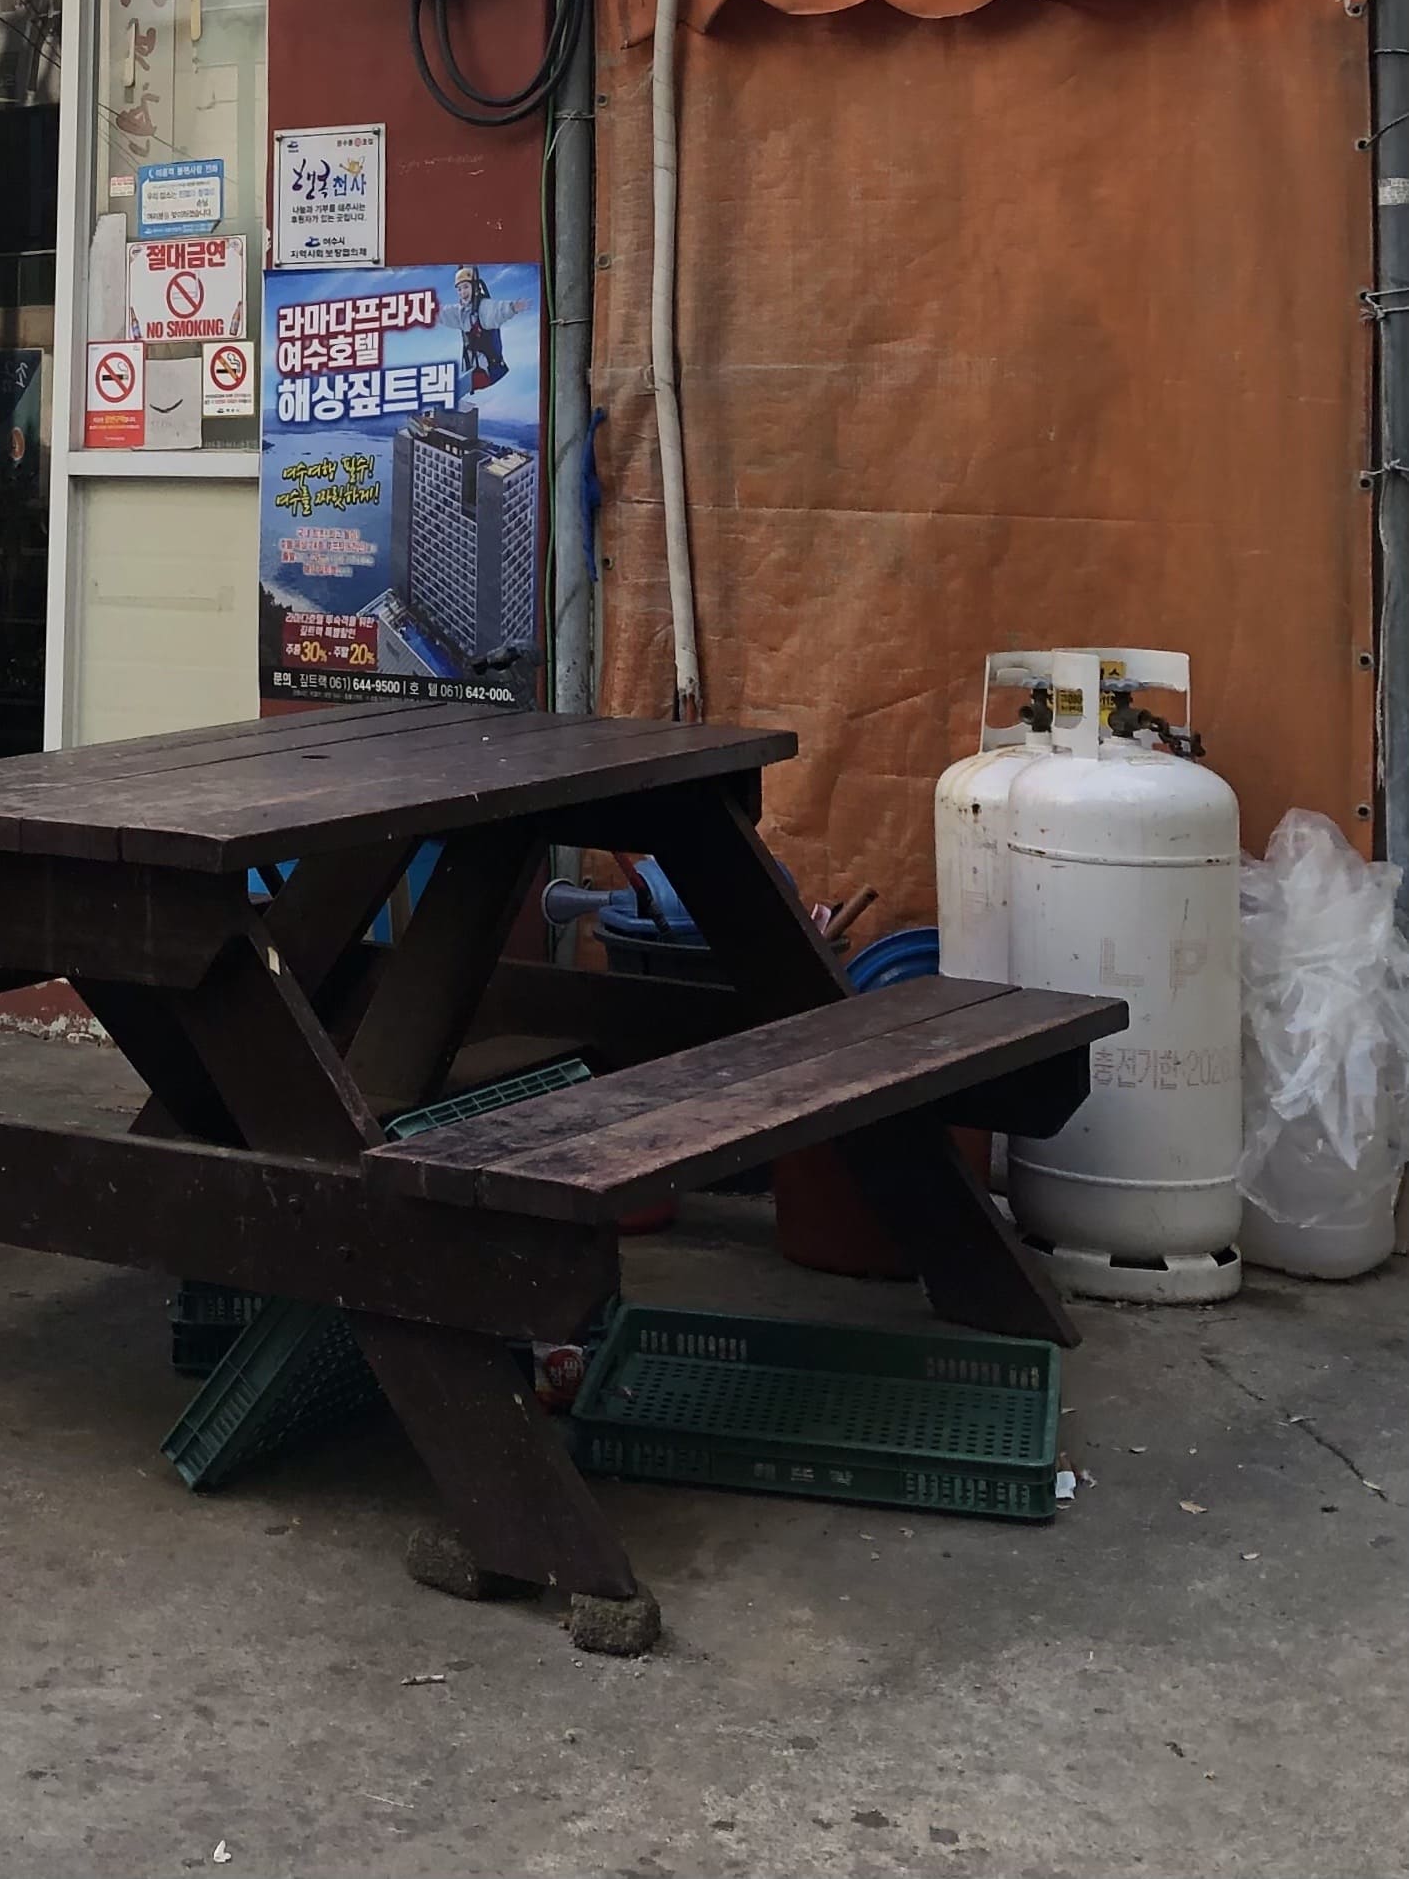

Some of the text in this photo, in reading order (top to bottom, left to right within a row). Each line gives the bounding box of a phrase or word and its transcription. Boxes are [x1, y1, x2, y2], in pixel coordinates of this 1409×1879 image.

[146, 239, 227, 272] 절대금연
[146, 318, 225, 339] NO SMOKING
[277, 290, 436, 339] 라마다프라자
[277, 331, 380, 373] 여수호텔
[329, 676, 351, 691] 061)
[353, 678, 401, 694] 644-9500
[440, 683, 464, 699] 061)
